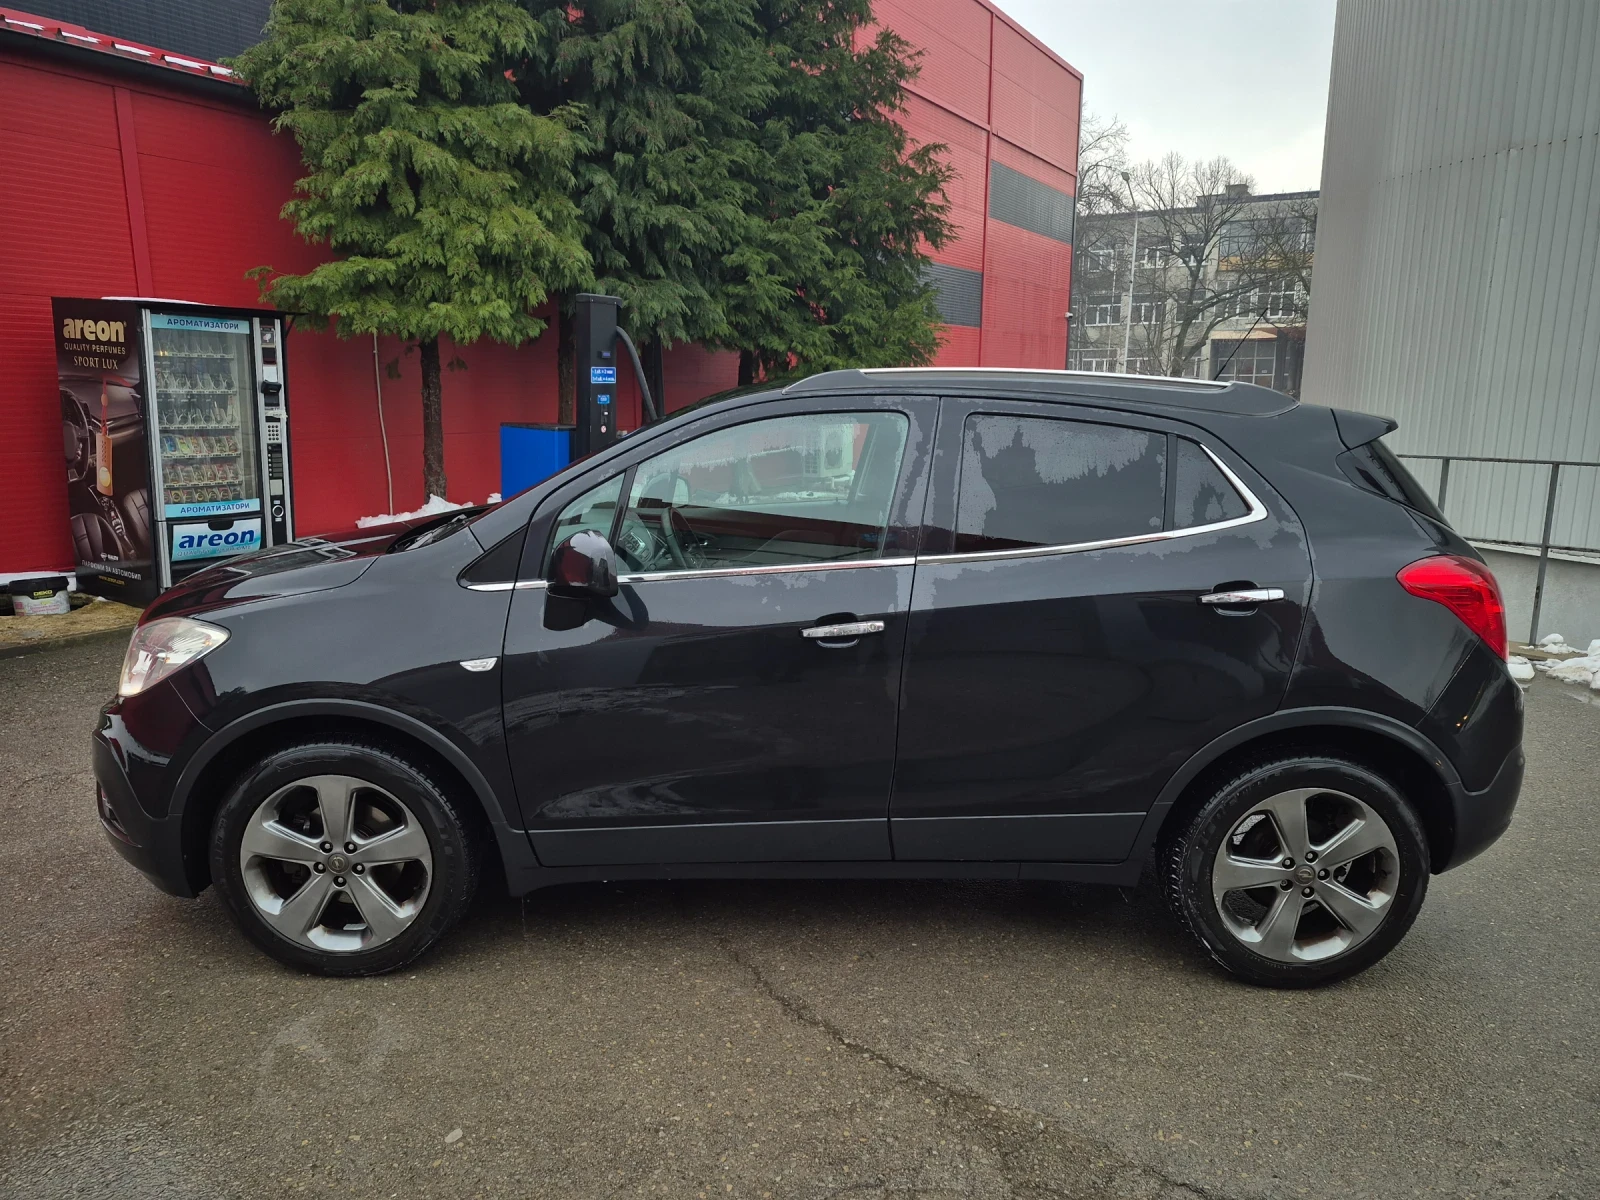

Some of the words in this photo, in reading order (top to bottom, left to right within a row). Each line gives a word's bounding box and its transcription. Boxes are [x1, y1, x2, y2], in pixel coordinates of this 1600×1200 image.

[63, 318, 124, 342] areon
[167, 318, 239, 329] АРОМАТИЗАТОРИ
[64, 342, 90, 351] QUALITY
[92, 344, 126, 354] PERFUMES
[74, 356, 99, 368] SPORT
[102, 358, 118, 370] LUX
[180, 503, 250, 514] АРОМАТИЗАТОРИ
[178, 529, 255, 549] areon
